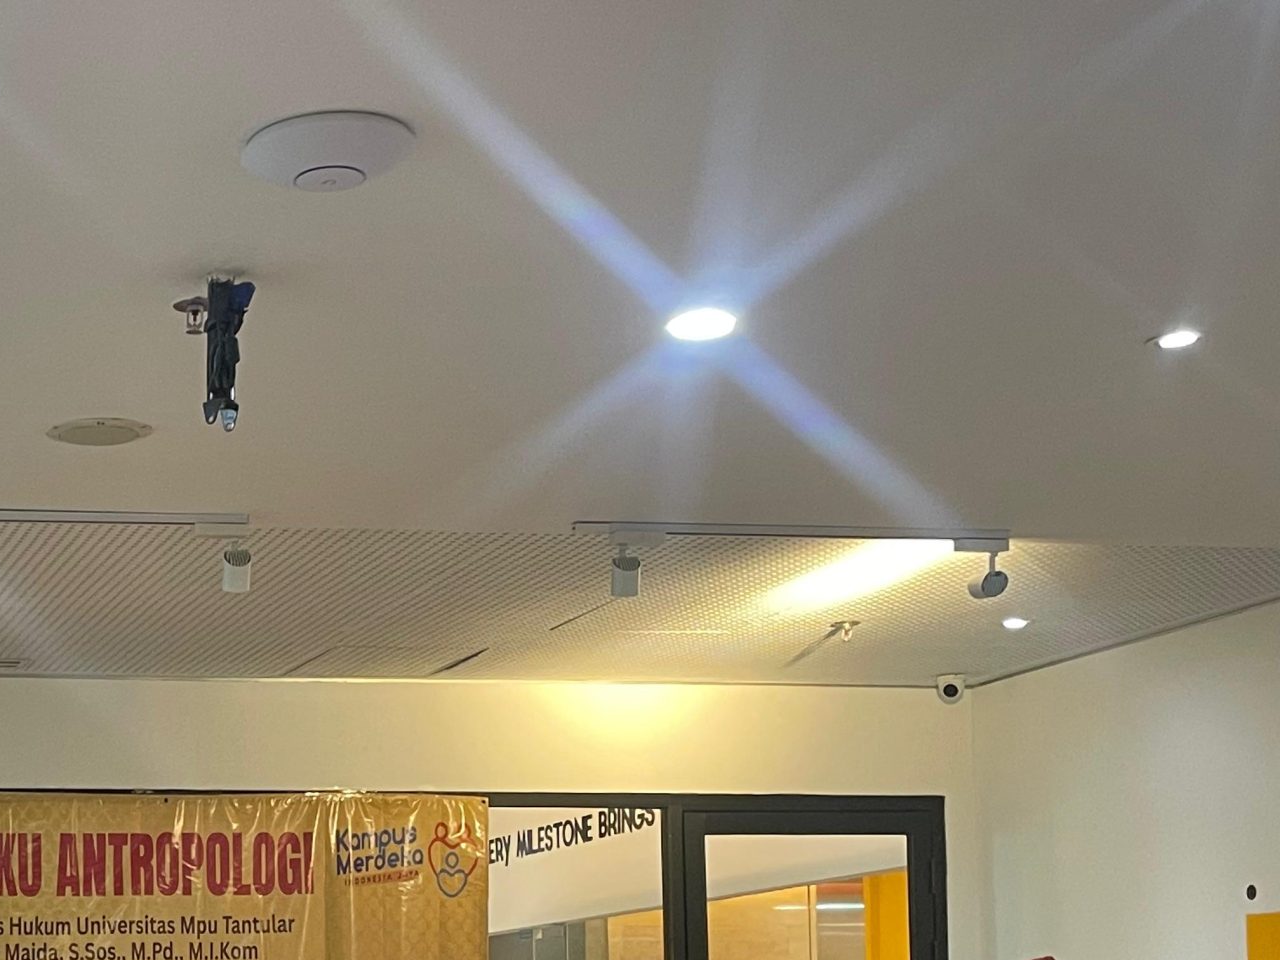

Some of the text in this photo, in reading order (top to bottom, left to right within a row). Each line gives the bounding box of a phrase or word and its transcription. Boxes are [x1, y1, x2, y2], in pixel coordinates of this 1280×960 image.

[336, 826, 417, 853] Kampus
[516, 814, 593, 858] MILESTONE
[598, 808, 655, 838] BRINGS
[56, 832, 315, 897] ANTROPOLOGI
[336, 846, 424, 875] Merdeka
[9, 916, 71, 936] Hukum
[77, 915, 175, 935] Universitas
[180, 916, 218, 939] Mpu
[222, 914, 296, 935] Tantular
[189, 941, 258, 960] M.I.Kom
